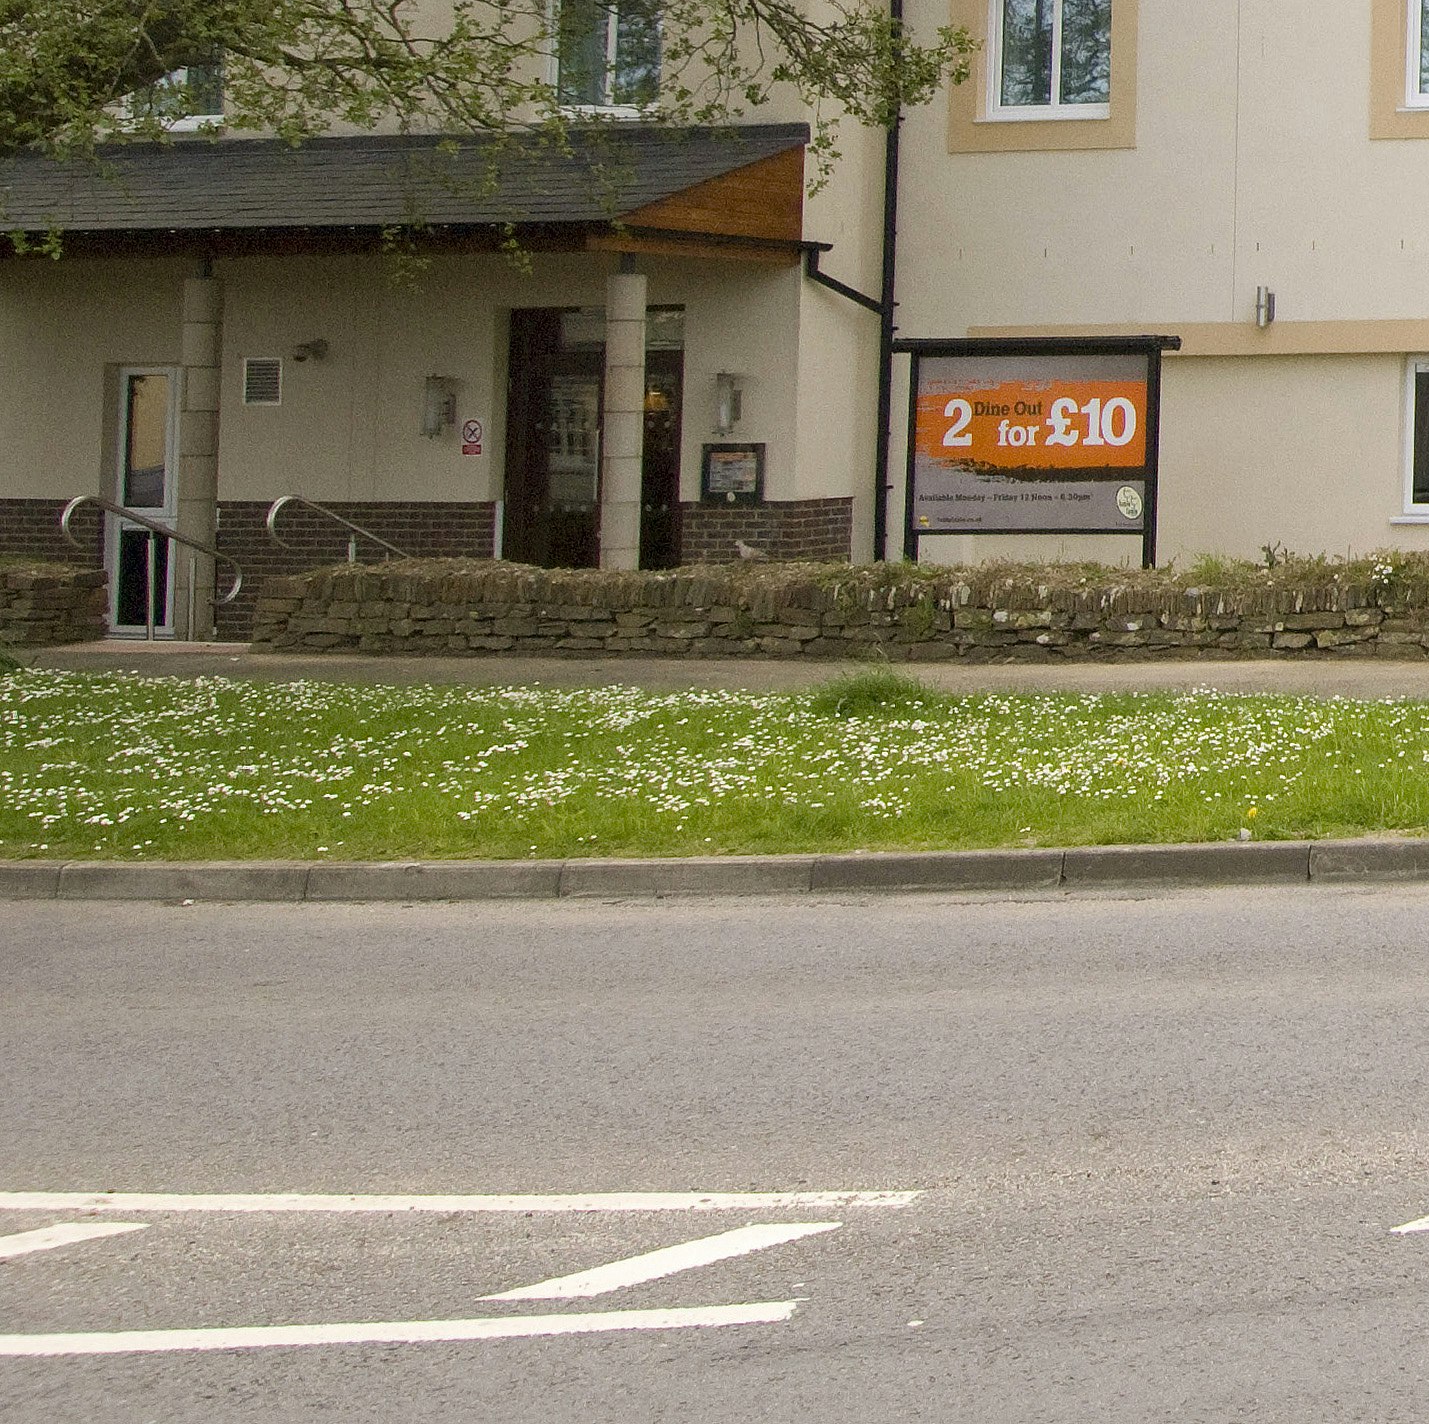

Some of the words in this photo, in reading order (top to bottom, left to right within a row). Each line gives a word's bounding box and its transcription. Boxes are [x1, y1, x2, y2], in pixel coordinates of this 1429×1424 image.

[942, 398, 973, 446] 2
[997, 419, 1040, 446] for
[1044, 396, 1137, 447] £10
[974, 401, 1011, 416] Dine
[1013, 401, 1043, 416] Out
